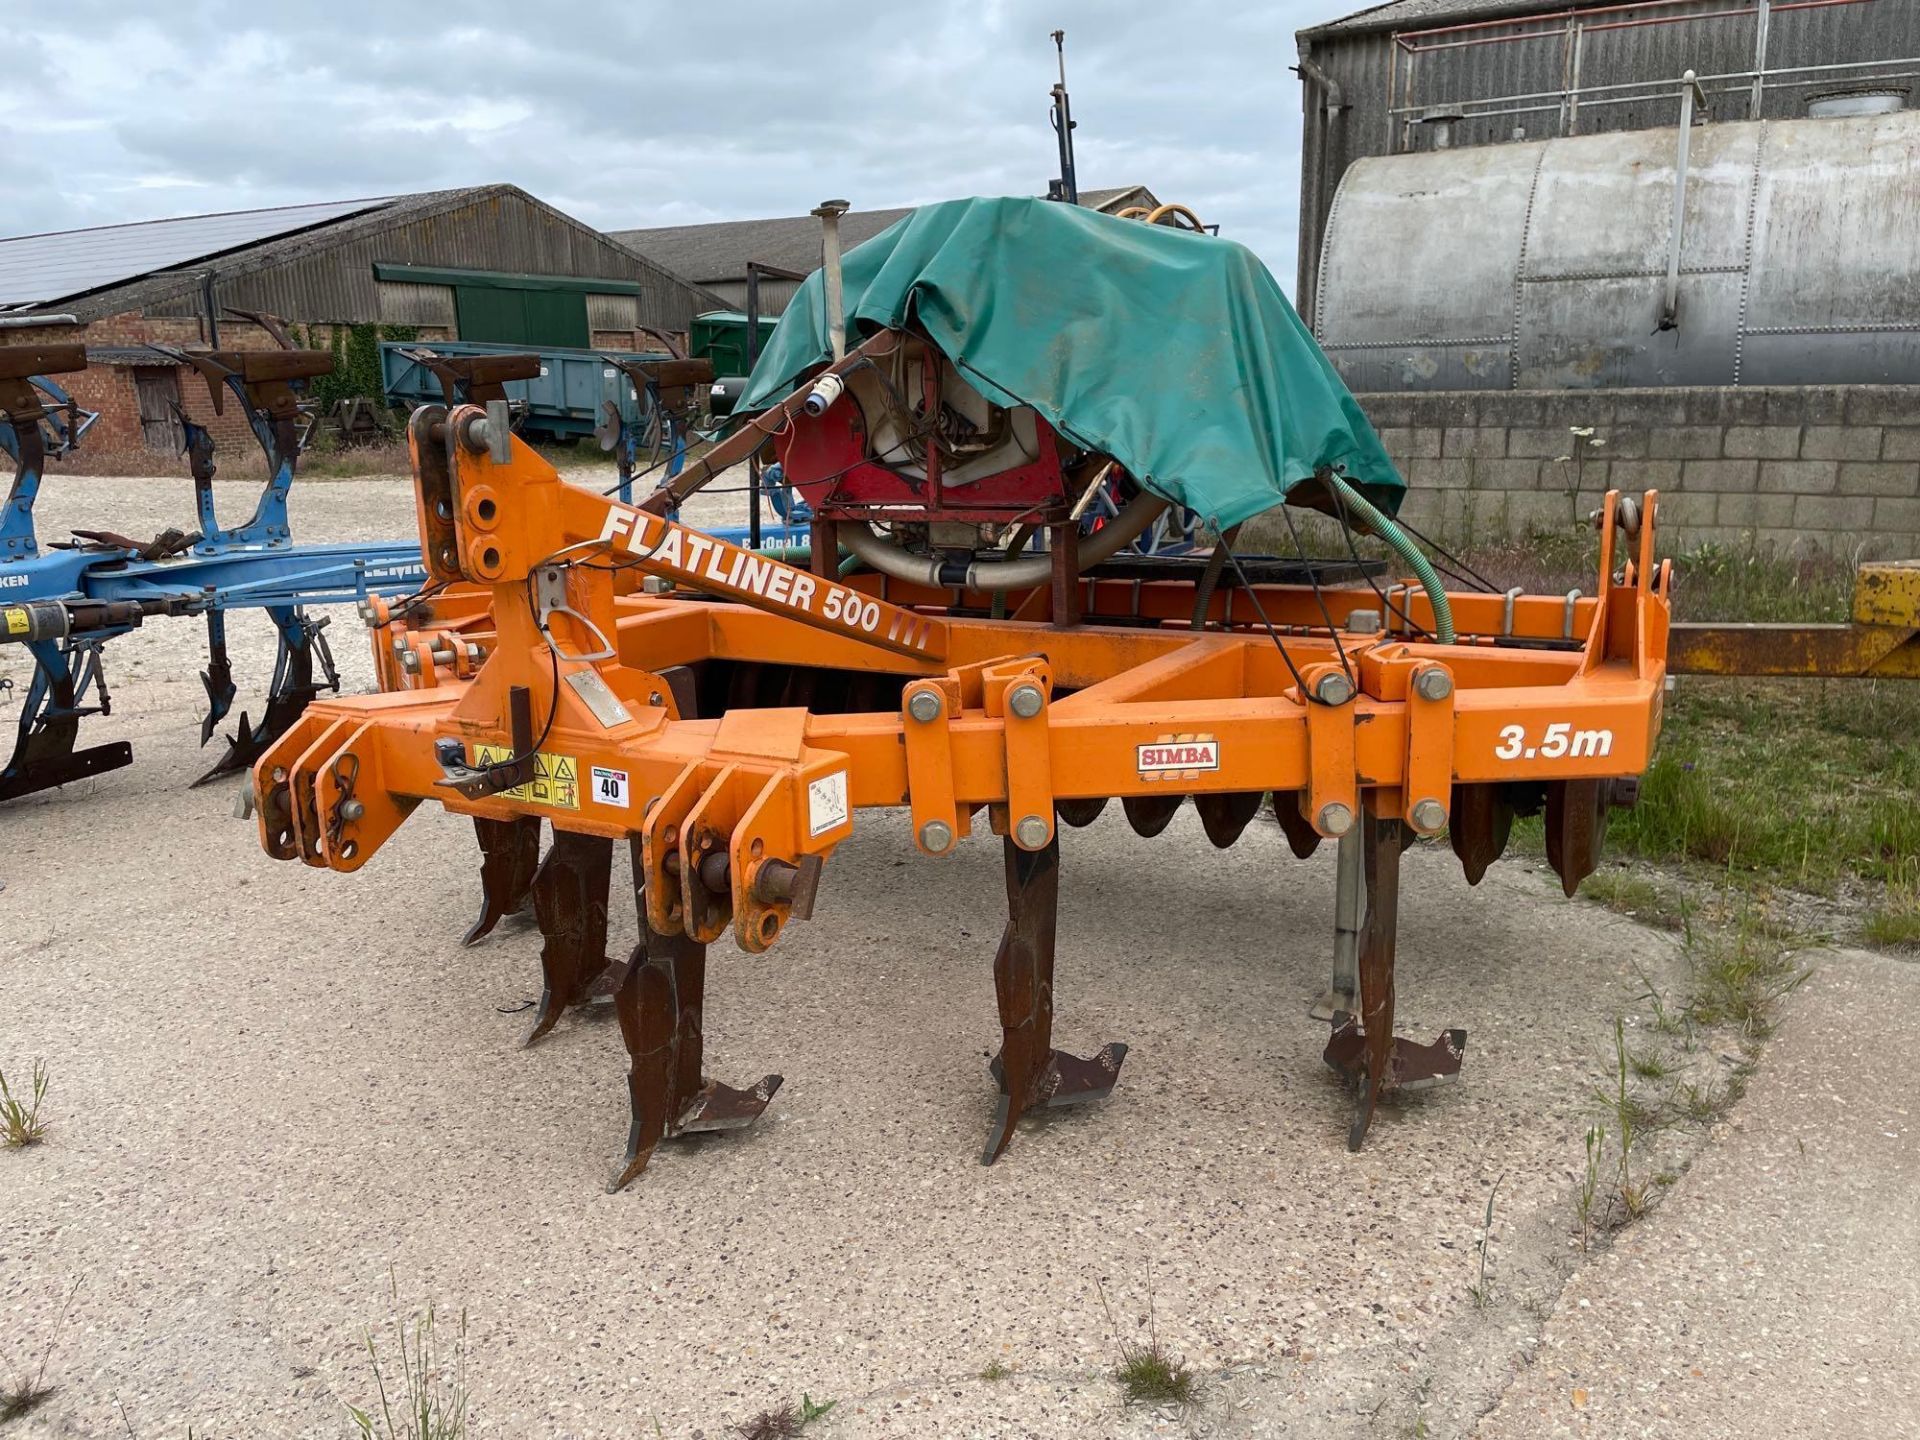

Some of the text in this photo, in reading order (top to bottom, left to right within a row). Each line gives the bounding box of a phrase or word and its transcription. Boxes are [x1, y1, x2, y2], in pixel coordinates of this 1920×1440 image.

[599, 505, 880, 632] FLATLINER 500
[1495, 722, 1613, 760] 3.5m
[1142, 747, 1213, 766] SIMBA
[601, 778, 619, 799] 40
